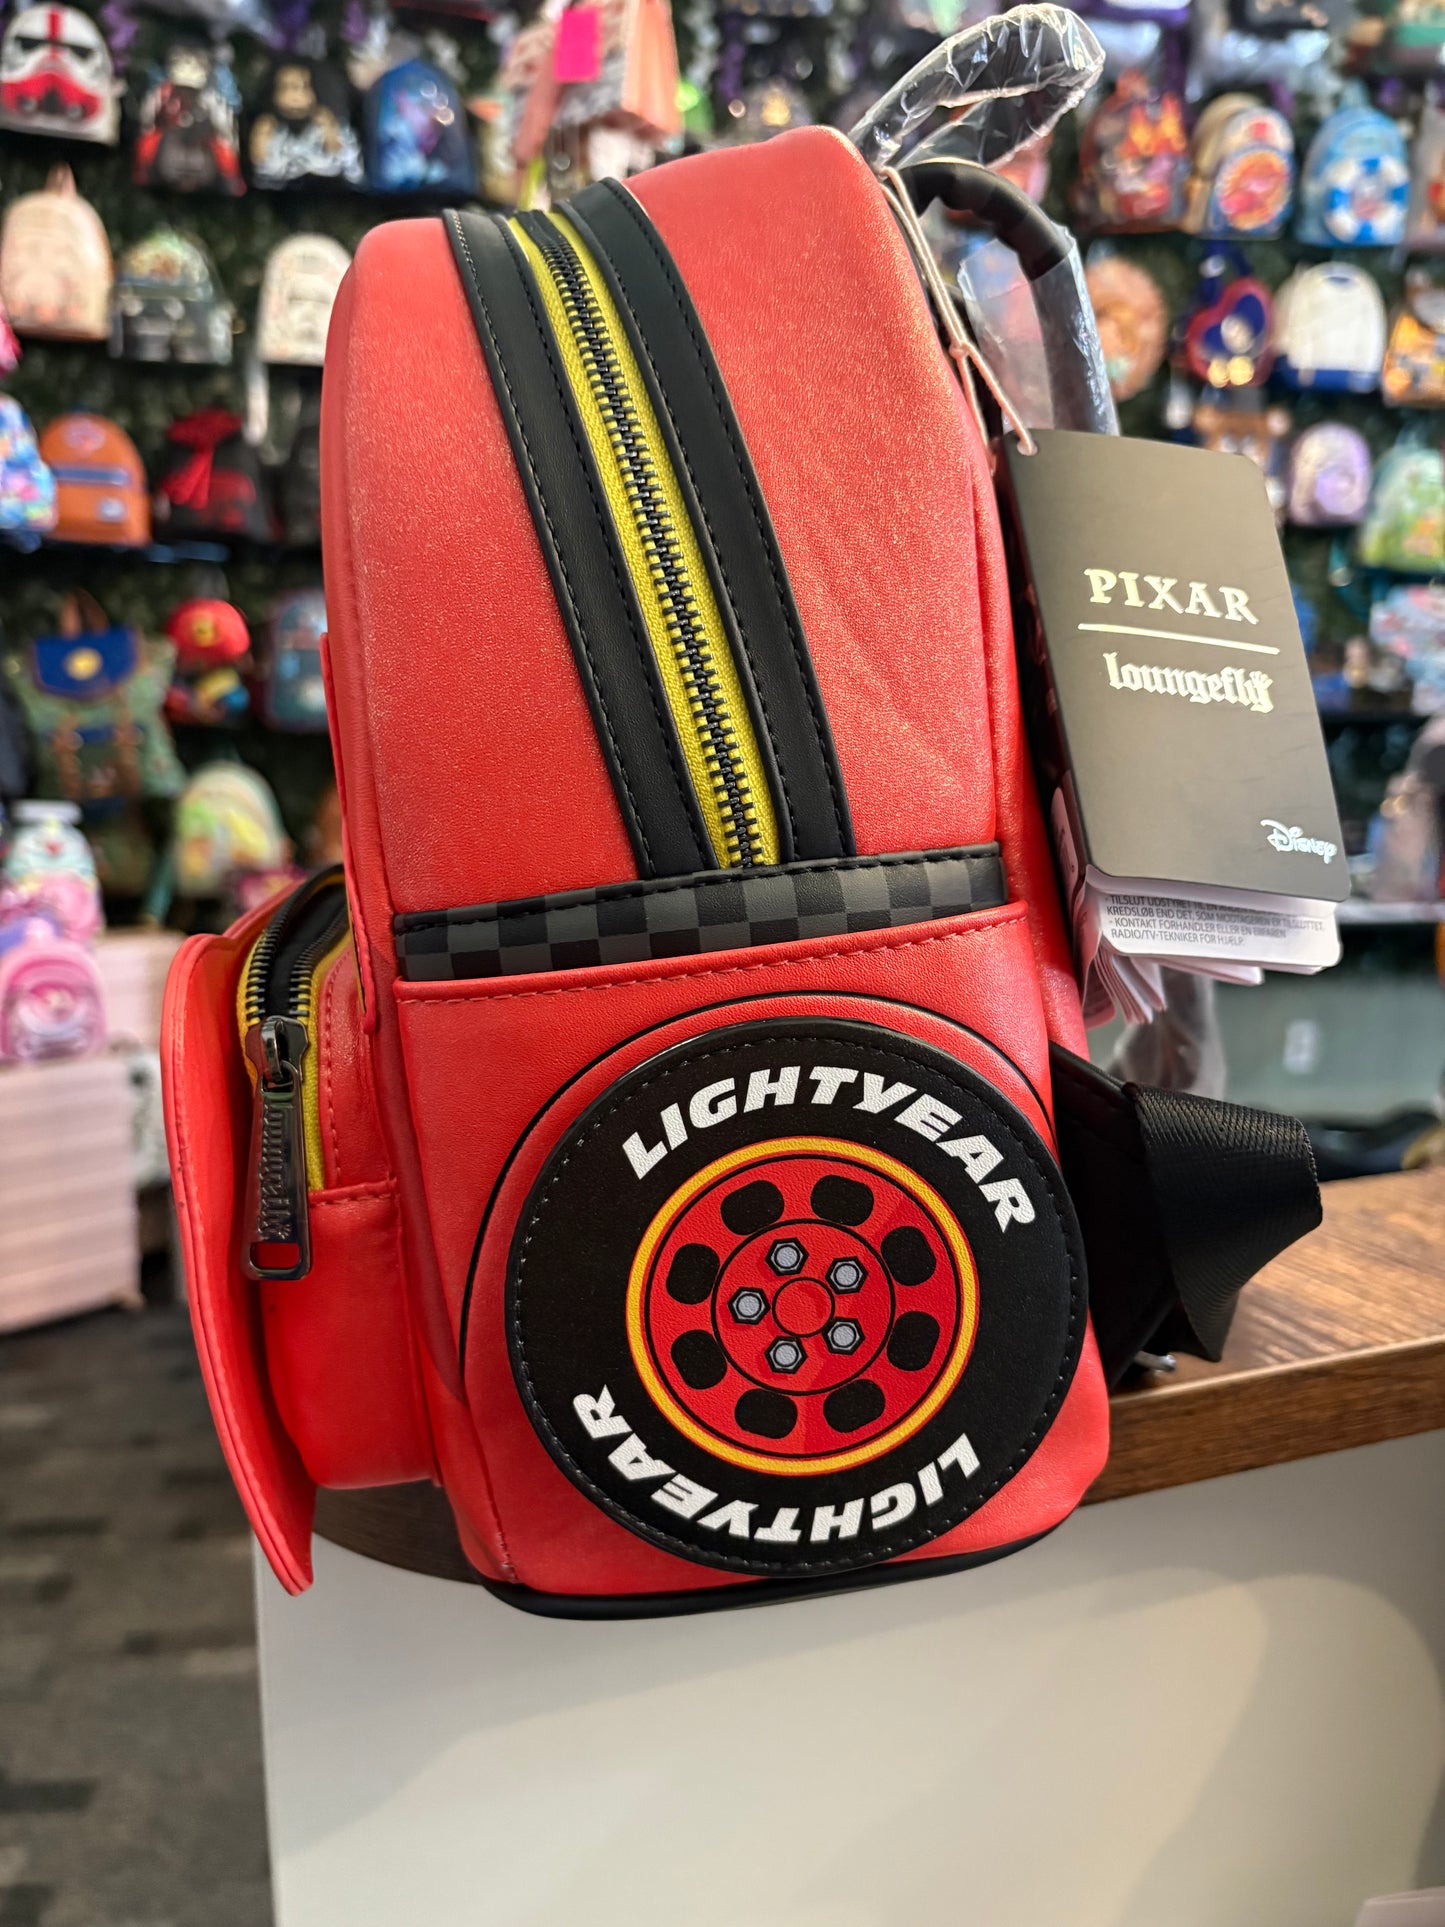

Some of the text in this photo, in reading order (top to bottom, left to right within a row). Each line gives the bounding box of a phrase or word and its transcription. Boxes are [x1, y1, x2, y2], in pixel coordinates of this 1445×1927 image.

[1083, 568, 1259, 625] PIXAR
[1260, 818, 1338, 864] Disney
[1107, 906, 1154, 917] KREDSLØB
[1156, 909, 1174, 919] END
[1111, 895, 1146, 905] TILSLUT
[1111, 929, 1199, 942] RADIO/TV-TEKNIKER
[1200, 934, 1216, 944] FOR
[1115, 918, 1156, 928] KONTAKT
[1159, 920, 1215, 933] FORHANDLER
[621, 1065, 1036, 1234] LIGHTYEAR
[571, 1383, 983, 1546] LIGHTYEAR
